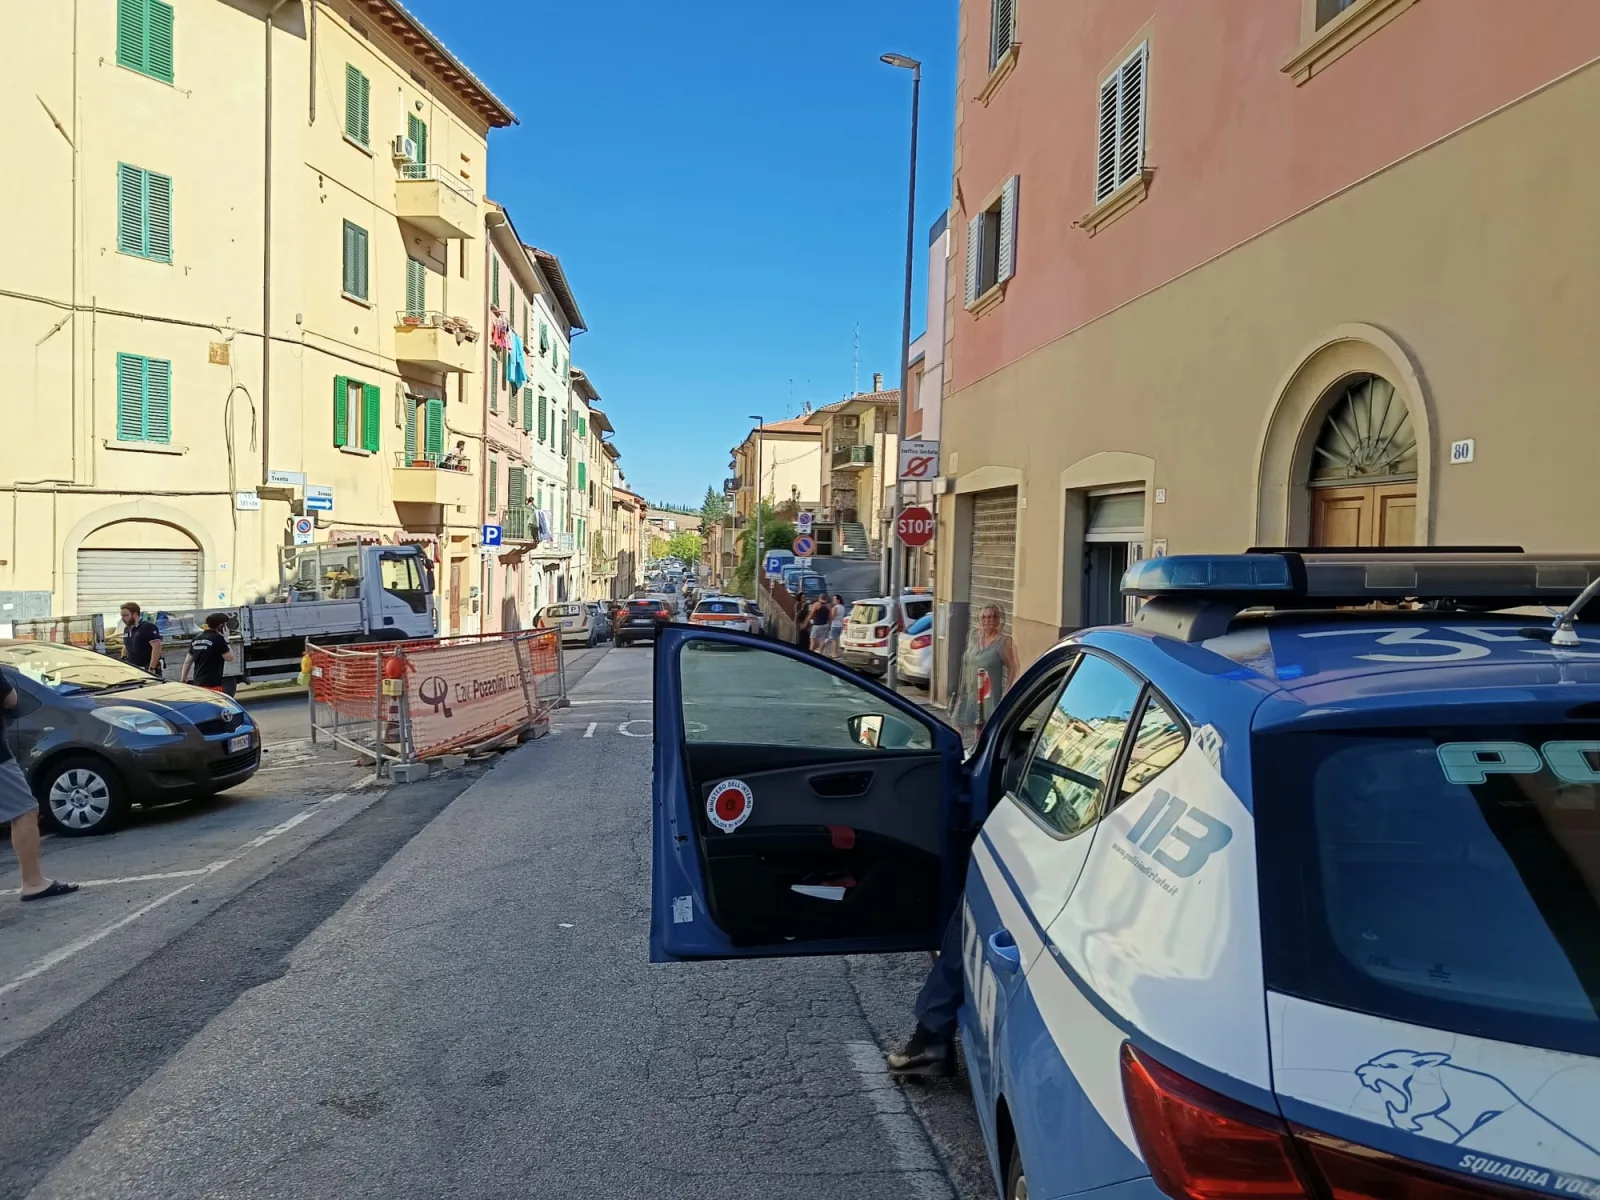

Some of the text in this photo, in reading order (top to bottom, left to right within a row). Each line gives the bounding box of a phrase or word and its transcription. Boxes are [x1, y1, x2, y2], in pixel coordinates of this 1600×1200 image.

[1454, 443, 1469, 460] 80
[486, 527, 499, 544] P
[898, 519, 934, 534] STOP
[769, 559, 780, 571] P
[473, 671, 507, 700] Pozzolini
[708, 784, 726, 812] MINISTERO
[1126, 788, 1233, 878] 113
[1458, 1154, 1550, 1187] SQUADRA
